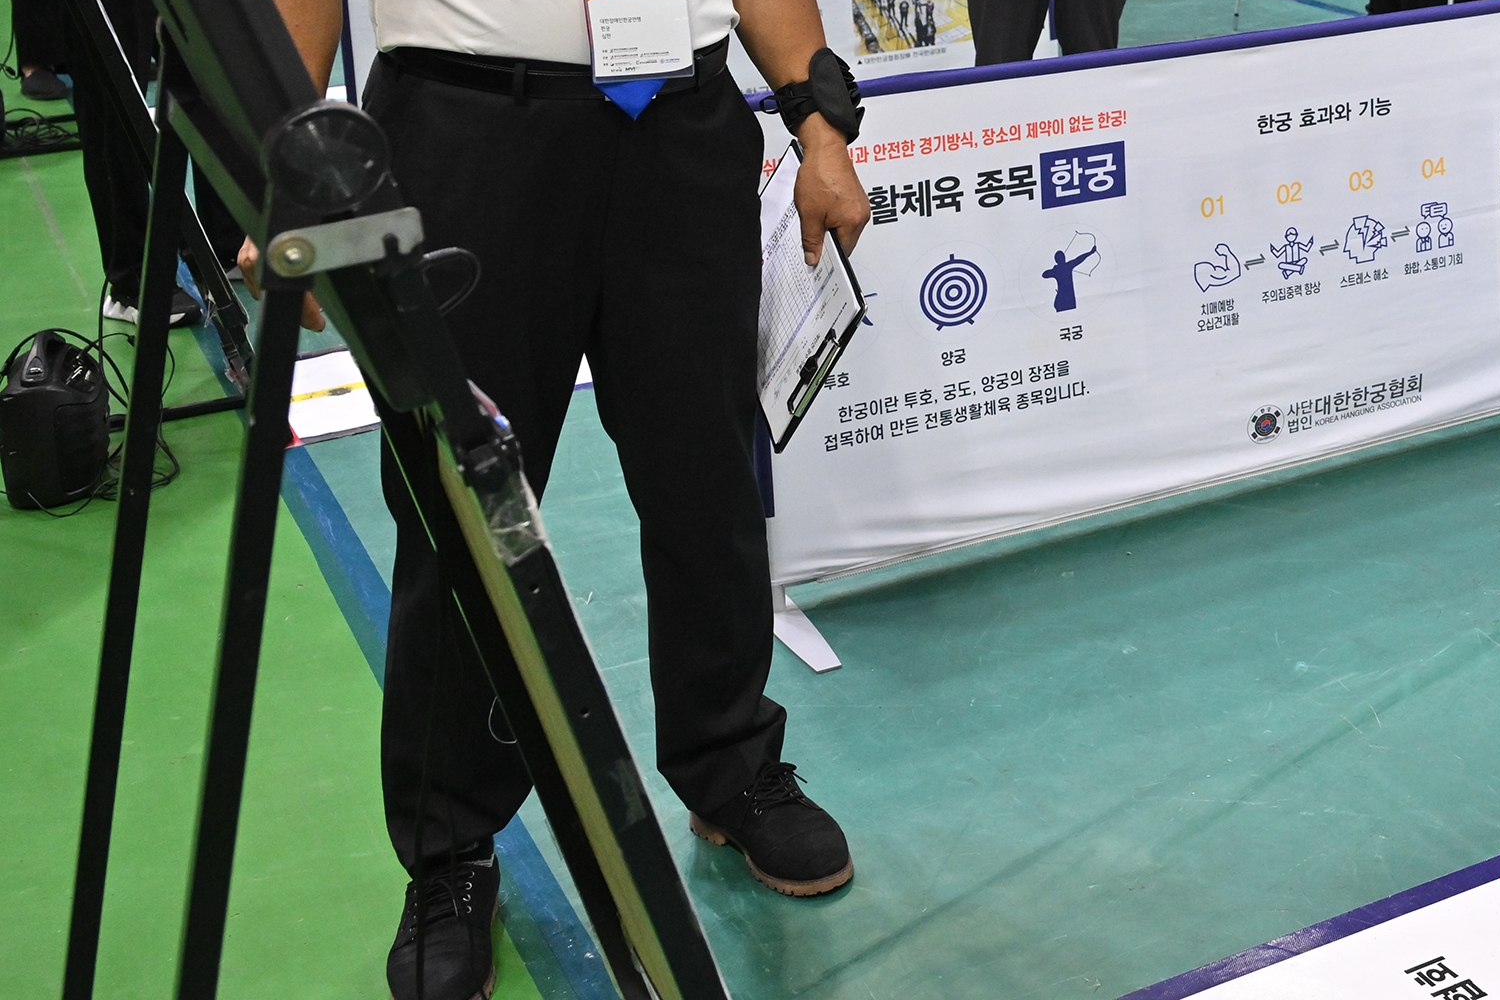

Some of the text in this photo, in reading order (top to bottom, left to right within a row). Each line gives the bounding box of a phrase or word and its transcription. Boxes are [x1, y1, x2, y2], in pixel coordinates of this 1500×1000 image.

[1257, 97, 1393, 135] 한궁 효과와 기능
[872, 109, 1128, 162] 안전한 경기방식, 장소의 제약이 없는 한궁!
[1421, 157, 1446, 179] 04
[974, 164, 1037, 209] 종목
[1050, 152, 1118, 199] 한궁
[1349, 169, 1375, 192] 03
[1276, 182, 1303, 205] 02
[1201, 195, 1225, 218] 01
[1404, 252, 1463, 275] 화합, 소통의 기회
[1340, 268, 1389, 288] 스트레스 해소
[1262, 281, 1321, 303] 주의집중력 향상
[1201, 298, 1235, 316] 치매예방
[1060, 325, 1084, 342] 국궁
[1197, 312, 1240, 333] 오십견재활
[941, 348, 967, 366] 양궁
[823, 372, 850, 391] 투호
[838, 359, 1071, 423] 한궁이란 투호, 궁도, 양궁의 장점을
[1287, 373, 1424, 416] 사단 대한한궁협회
[823, 379, 1091, 453] 접목하여 만든 전통생활체육 종목입니다.
[1315, 395, 1423, 427] KOREA HANGUNG ASSOCIATION
[1288, 417, 1313, 433] 법인
